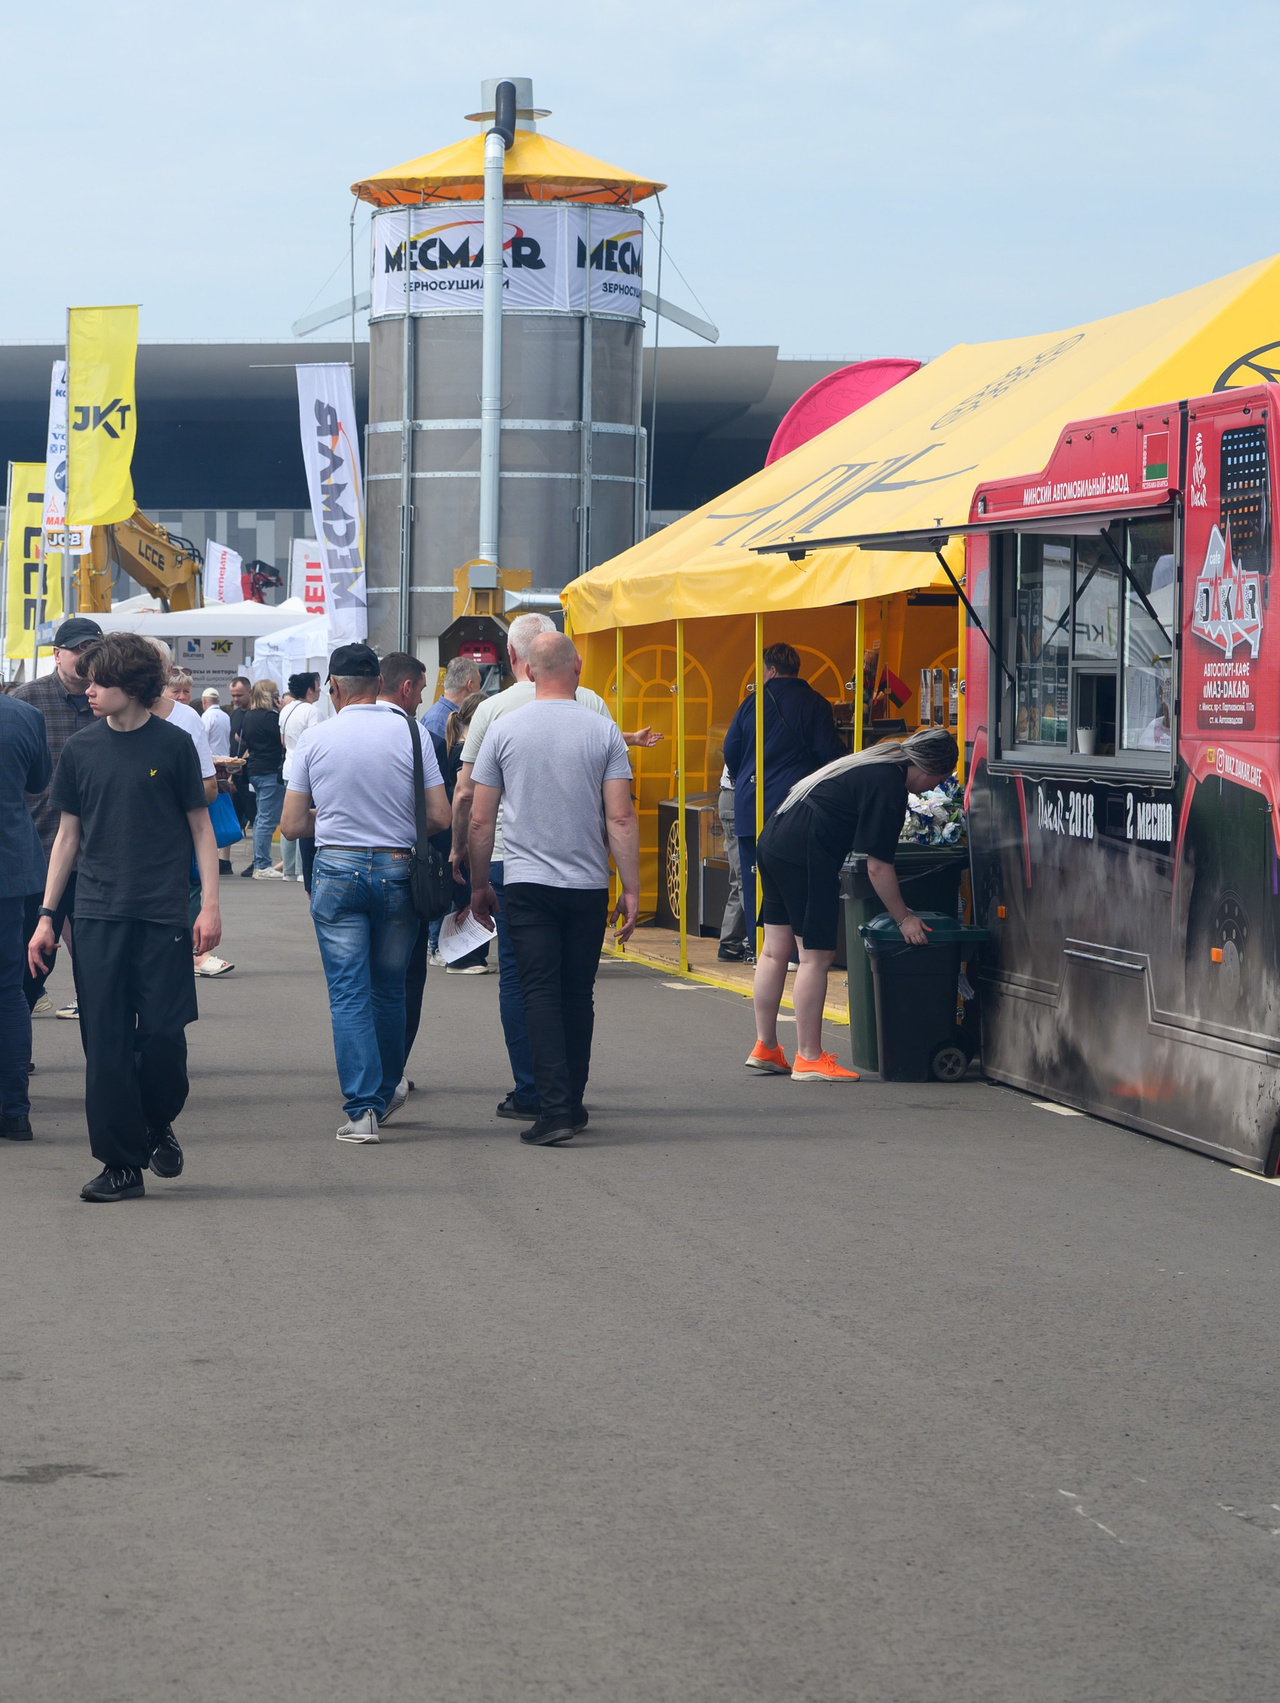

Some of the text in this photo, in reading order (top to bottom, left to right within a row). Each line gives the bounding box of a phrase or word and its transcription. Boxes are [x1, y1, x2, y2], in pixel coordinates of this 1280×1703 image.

[384, 236, 546, 274] MECMR
[72, 398, 131, 439] JKT
[1023, 472, 1130, 506] МИНСКИЙ АВТОМОБИЛЬНЫЙ ЗАВОД
[1203, 662, 1250, 677] АВТОСПОРТ-КАФЕ
[1126, 792, 1134, 840] 2
